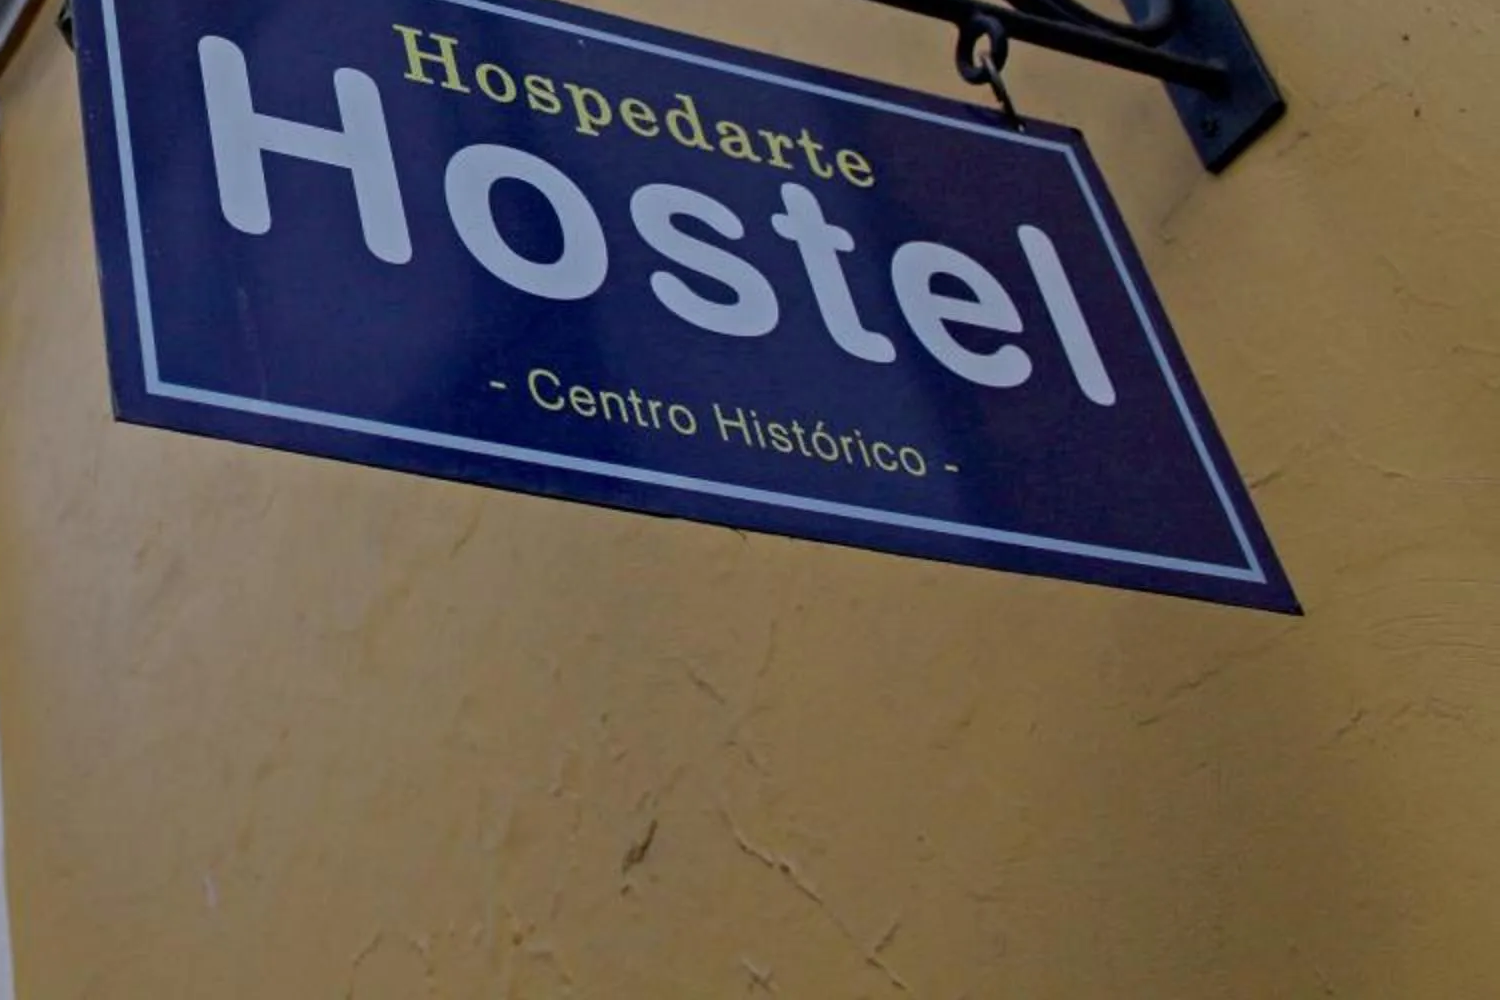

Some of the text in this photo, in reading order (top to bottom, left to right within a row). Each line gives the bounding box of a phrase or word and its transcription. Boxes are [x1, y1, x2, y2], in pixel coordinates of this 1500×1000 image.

[393, 24, 875, 188] Hospedarte
[197, 34, 1116, 406] Hostel
[527, 368, 698, 437] Centro
[712, 403, 928, 478] Histórico
